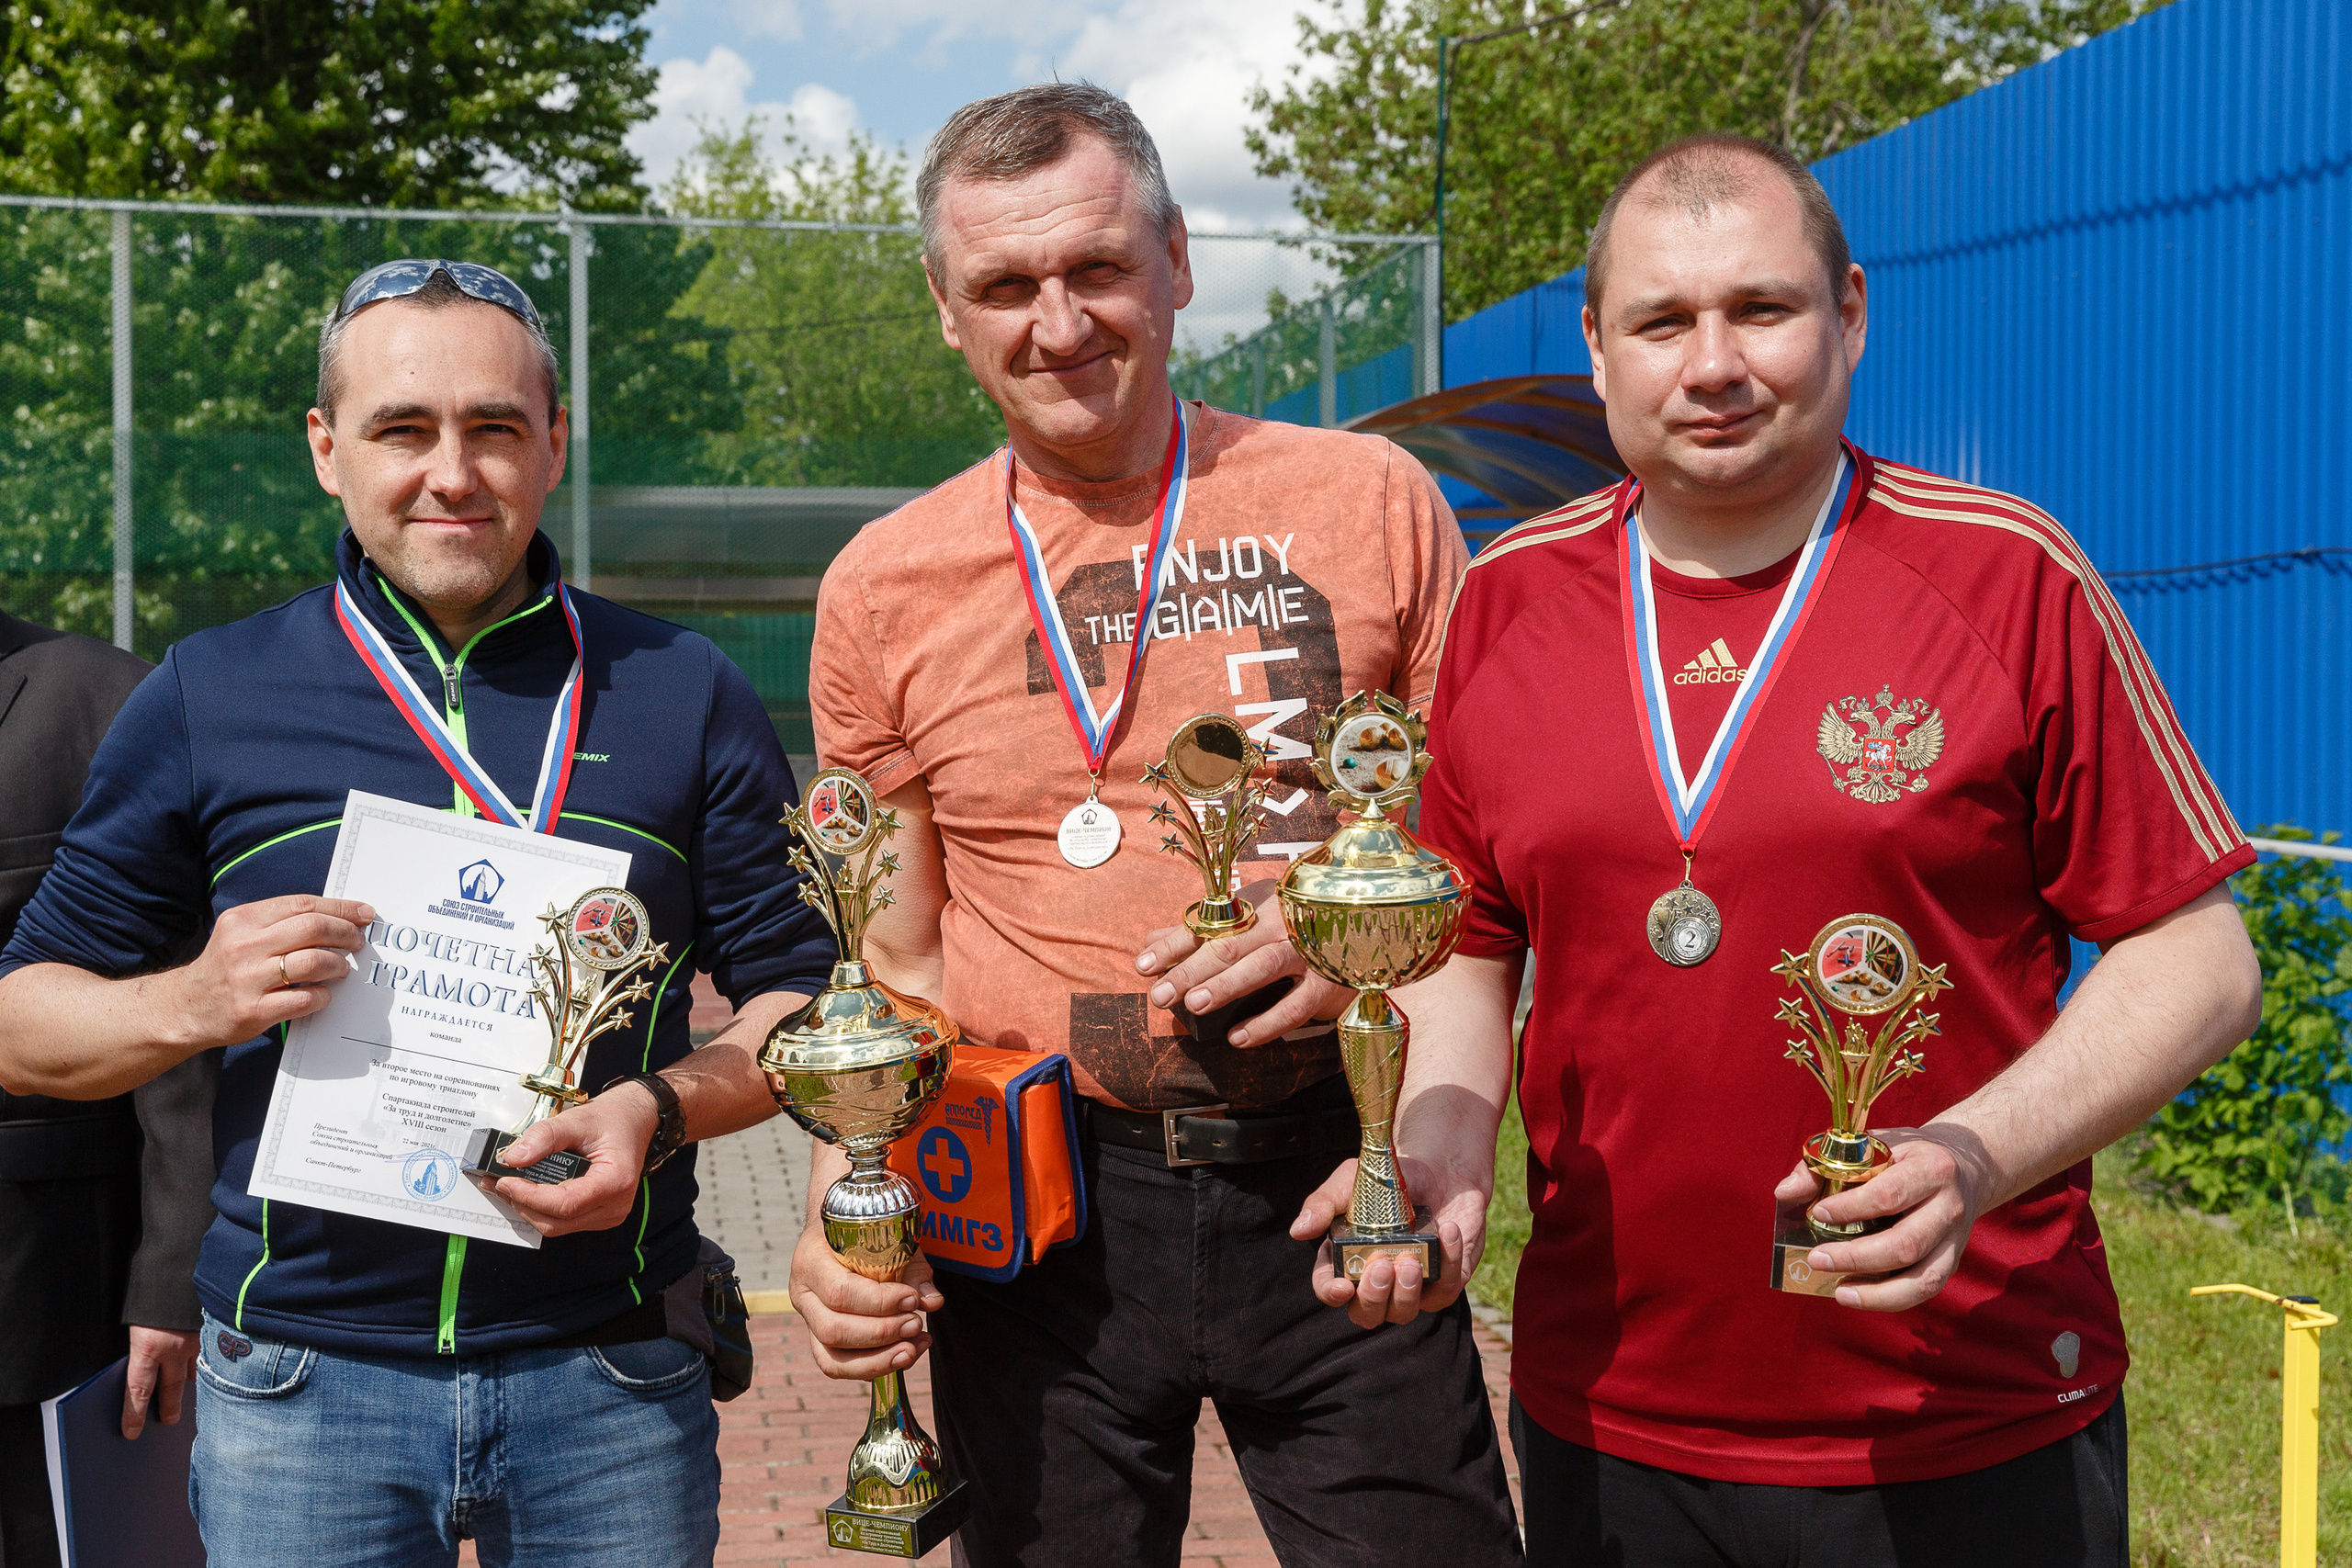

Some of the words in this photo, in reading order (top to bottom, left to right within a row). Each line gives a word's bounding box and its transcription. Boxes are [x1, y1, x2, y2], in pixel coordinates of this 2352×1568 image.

[1084, 612, 1137, 645] THE
[1673, 666, 1748, 685] adidas
[572, 751, 611, 762] EMIX
[427, 904, 469, 920] ОБЪЕДИНЕНИЙ
[469, 914, 474, 922] И
[474, 915, 514, 931] ОРГАНИЗАЦИЙ
[442, 898, 460, 910] СОЮЗ
[460, 902, 504, 919] СТРОИТЕЛЬНЫХ
[1684, 929, 1697, 949] 2
[365, 959, 537, 1020] ГРАМОТА
[401, 1005, 493, 1032] НАГРАЖДАЕТСЯ
[429, 1031, 462, 1043] команда
[371, 1058, 380, 1067] За
[381, 1063, 408, 1073] второе
[410, 1068, 432, 1077] место
[444, 1075, 501, 1092] соревнованиях
[401, 1077, 437, 1090] игровому
[439, 1084, 479, 1099] триатлону
[382, 1092, 432, 1110] Спартакиада
[432, 1104, 476, 1118] строителей
[383, 1104, 397, 1112] «За
[398, 1107, 416, 1117] труд
[424, 1112, 472, 1127] долголетие»
[313, 1122, 348, 1134] Президент
[401, 1117, 424, 1129] XVIII
[424, 1123, 447, 1134] сезон
[310, 1139, 350, 1152] объединений
[355, 1148, 393, 1160] организаций
[311, 1130, 333, 1140] Союза
[333, 1135, 379, 1149] строительных
[305, 1156, 362, 1174] Санкт-Петербург
[546, 1153, 575, 1167] НИКУ
[922, 1210, 1005, 1252] ИМГЗ
[2057, 1383, 2098, 1404] CLIMALITE
[852, 1517, 910, 1532] ВИЦЕ-ЧЕМПИОНУ
